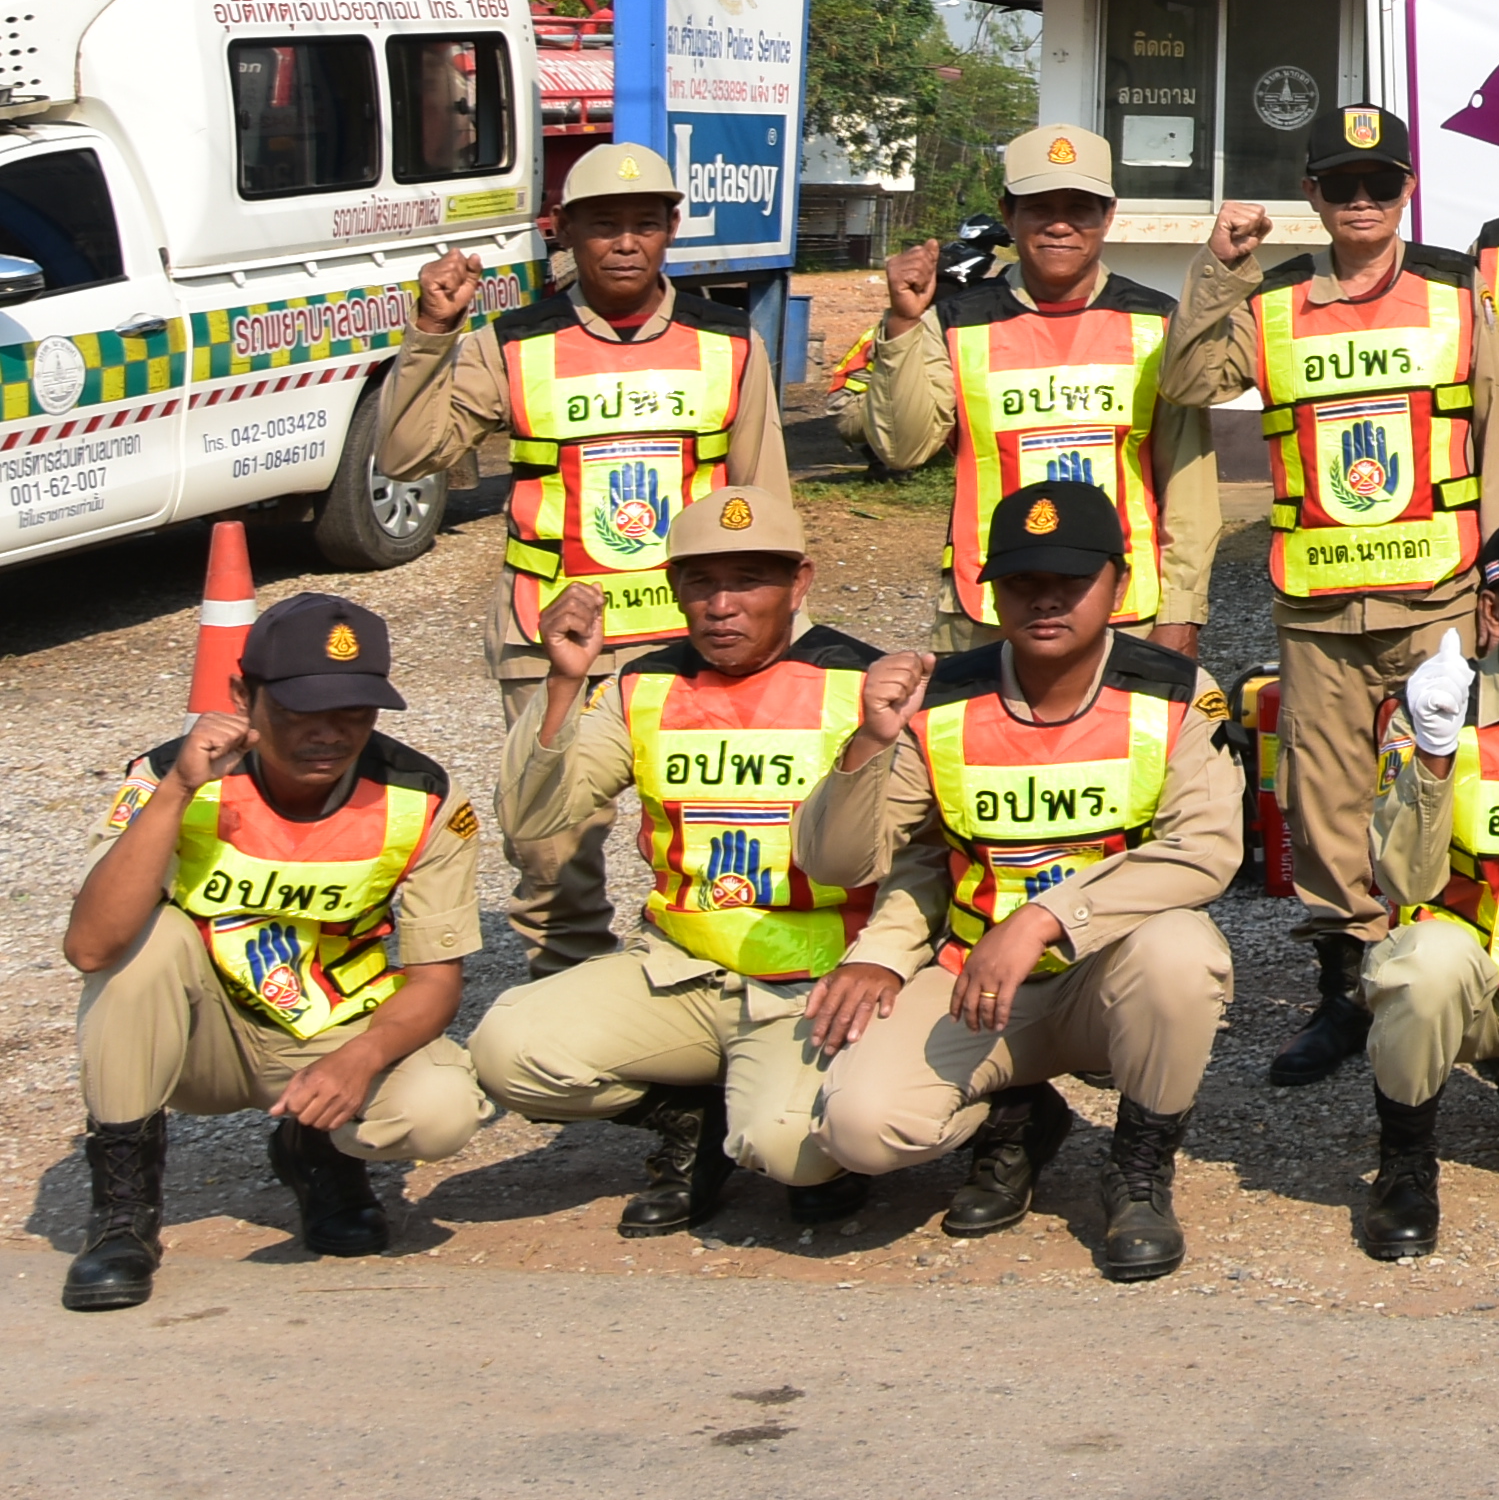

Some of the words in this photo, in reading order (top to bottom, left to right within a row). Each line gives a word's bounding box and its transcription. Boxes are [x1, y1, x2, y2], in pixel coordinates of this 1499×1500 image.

[727, 26, 754, 62] Police
[757, 29, 791, 64] Service
[1133, 30, 1185, 58] ติดต่อ
[772, 83, 791, 105] 191
[1117, 86, 1196, 105] สอบถาม
[673, 123, 779, 239] Lactasoy
[1304, 340, 1425, 382] อปพร.
[567, 381, 696, 422] อปพร.
[1002, 375, 1124, 416] อปพร.
[230, 409, 328, 448] 042-003428
[0, 433, 142, 482] ารบริหารส่วนตำบลนากอก
[232, 440, 327, 479] 061-0846101
[1306, 538, 1432, 566] อบต.นากอก
[666, 740, 806, 786] อปพร.
[975, 776, 1118, 823] อปพร.
[202, 870, 353, 911] อปพร.
